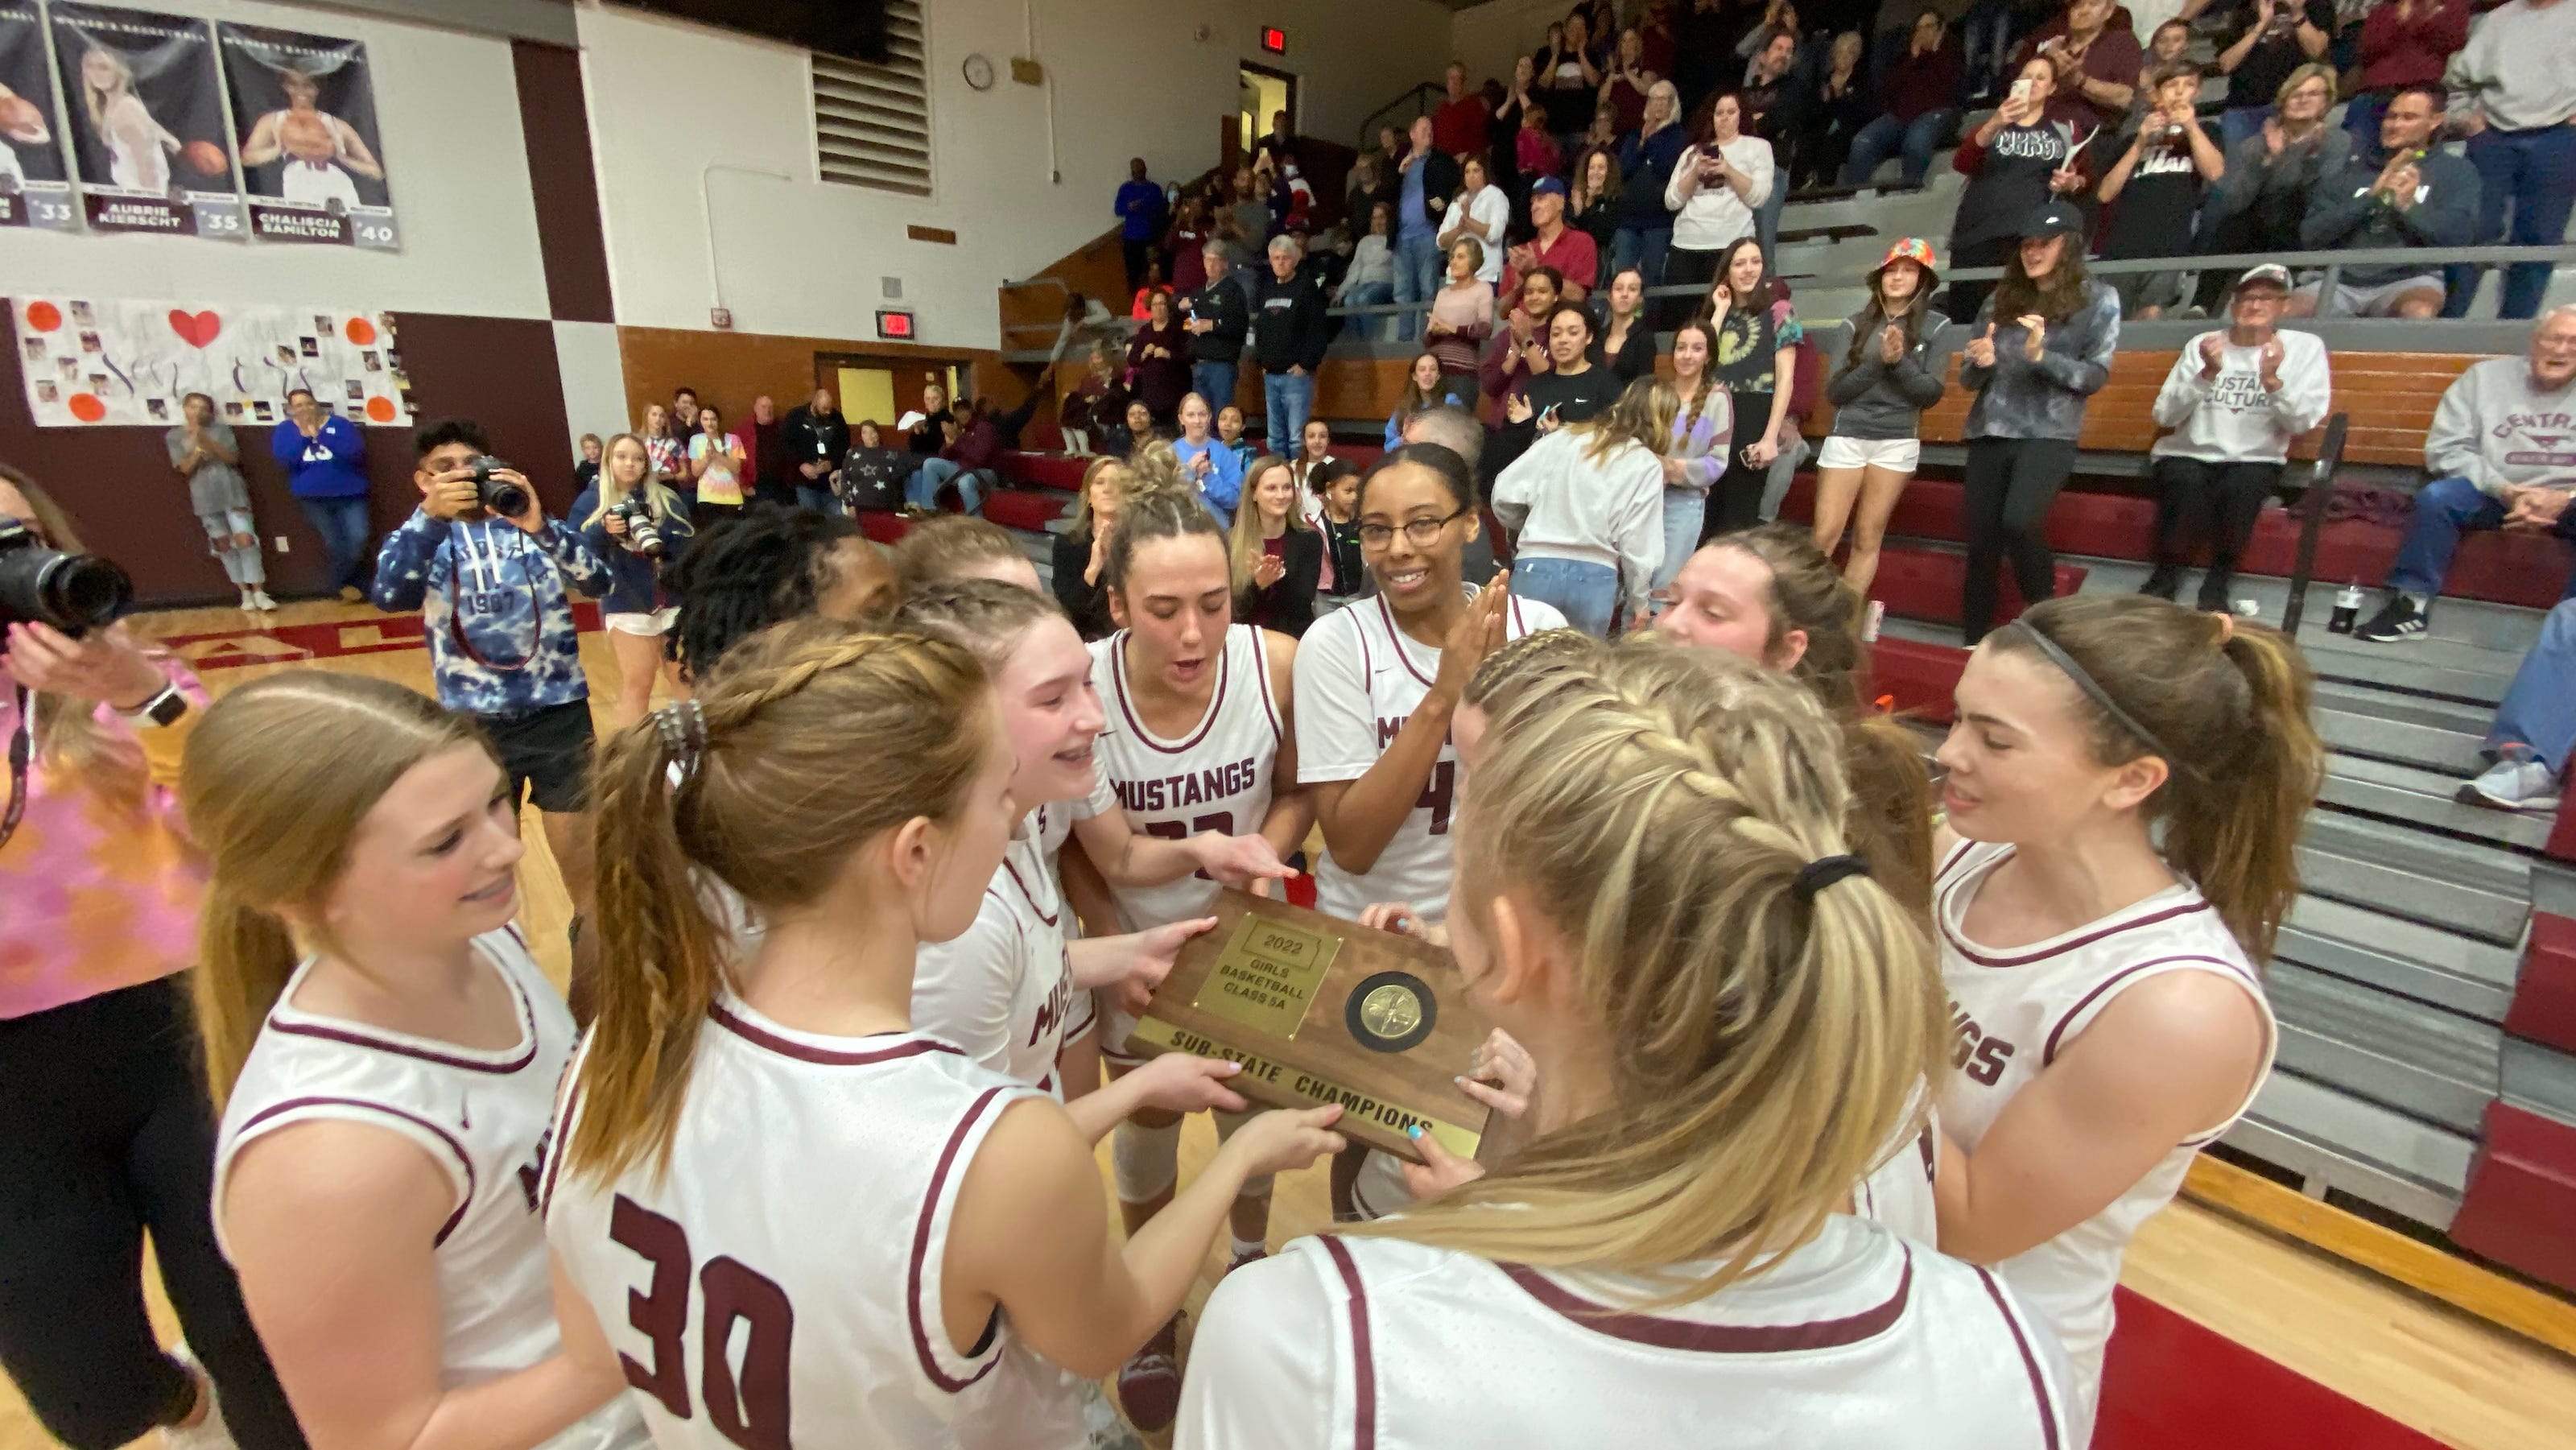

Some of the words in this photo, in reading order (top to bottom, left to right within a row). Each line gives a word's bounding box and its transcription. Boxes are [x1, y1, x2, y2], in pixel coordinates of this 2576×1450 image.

[98, 213, 182, 228] KIERSCHT
[109, 204, 170, 216] AUBRIE
[258, 213, 341, 229] CHALISCIA
[262, 223, 340, 239] SAMILTON
[2492, 412, 2576, 439] CENTR
[466, 590, 515, 614] 1907
[1108, 757, 1255, 812] MUSTANGS
[1264, 933, 1303, 956] 2022
[1249, 958, 1290, 978] GIRLS
[1219, 964, 1303, 1001] BASKETBALL
[1223, 981, 1267, 1006] CLASS
[1268, 996, 1286, 1010] 5A
[609, 1192, 795, 1450] 30
